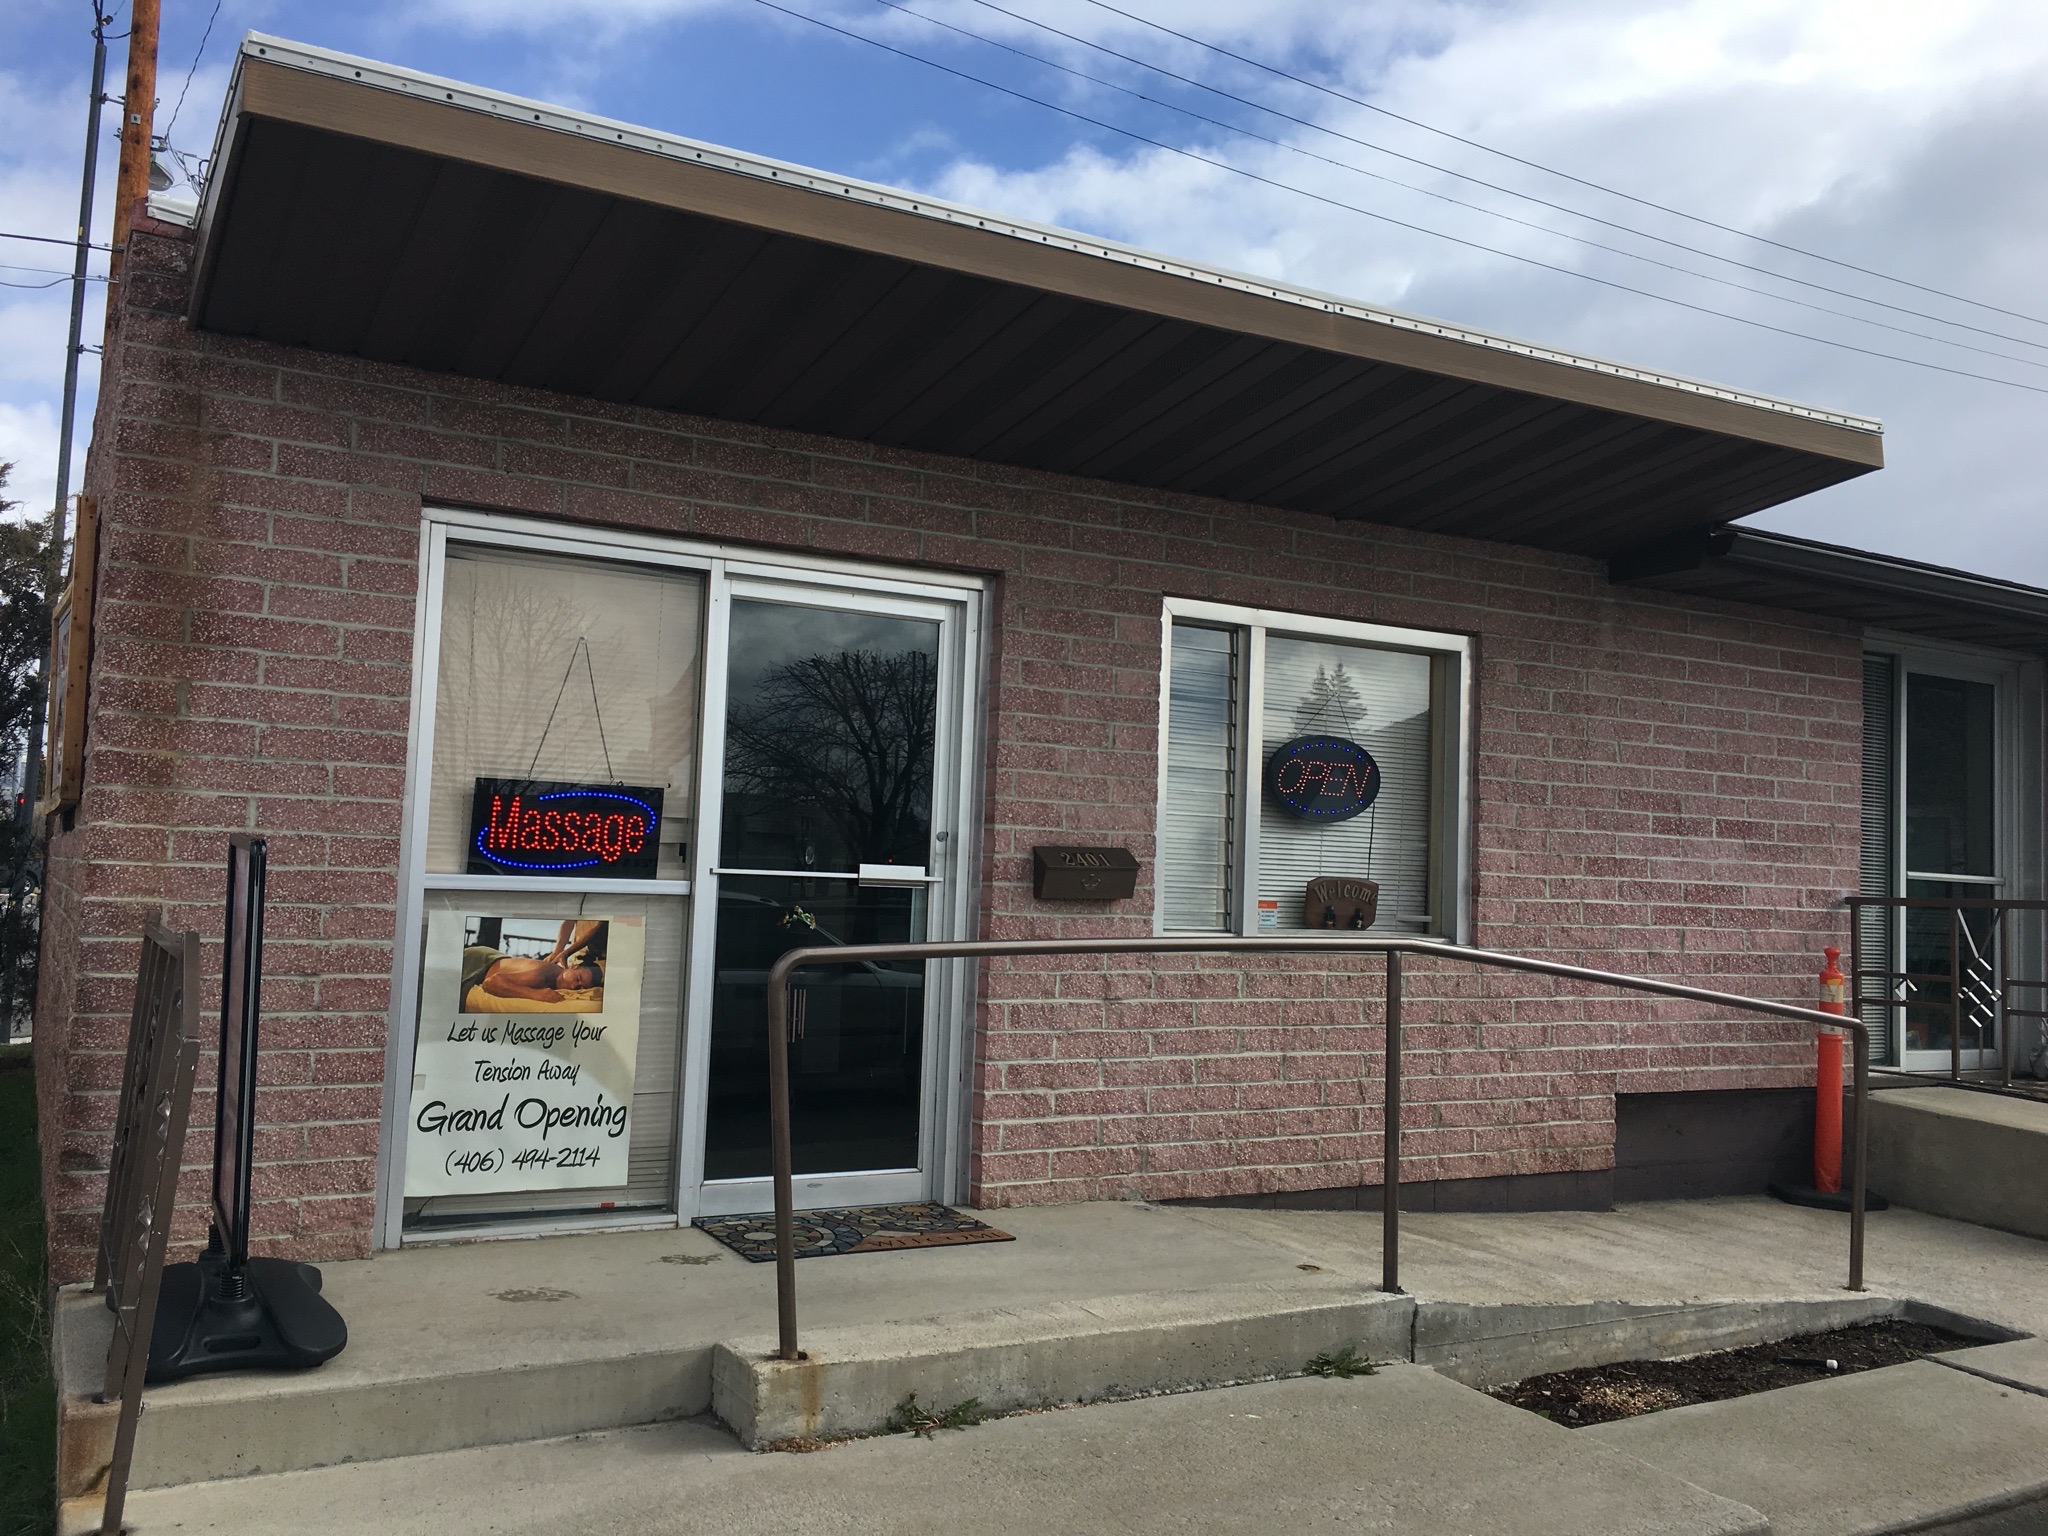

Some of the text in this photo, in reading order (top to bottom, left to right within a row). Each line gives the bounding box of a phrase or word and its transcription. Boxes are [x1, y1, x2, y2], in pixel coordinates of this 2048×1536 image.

[1277, 758, 1372, 798] OPEN
[488, 794, 645, 863] Massage
[1060, 852, 1112, 867] 2401
[1313, 880, 1378, 906] Welcome
[447, 1019, 608, 1049] Let us Massage Your
[474, 1058, 581, 1086] Tension Away
[416, 1092, 627, 1140] Grand Opening
[445, 1145, 601, 1176] (406) 494-2114
